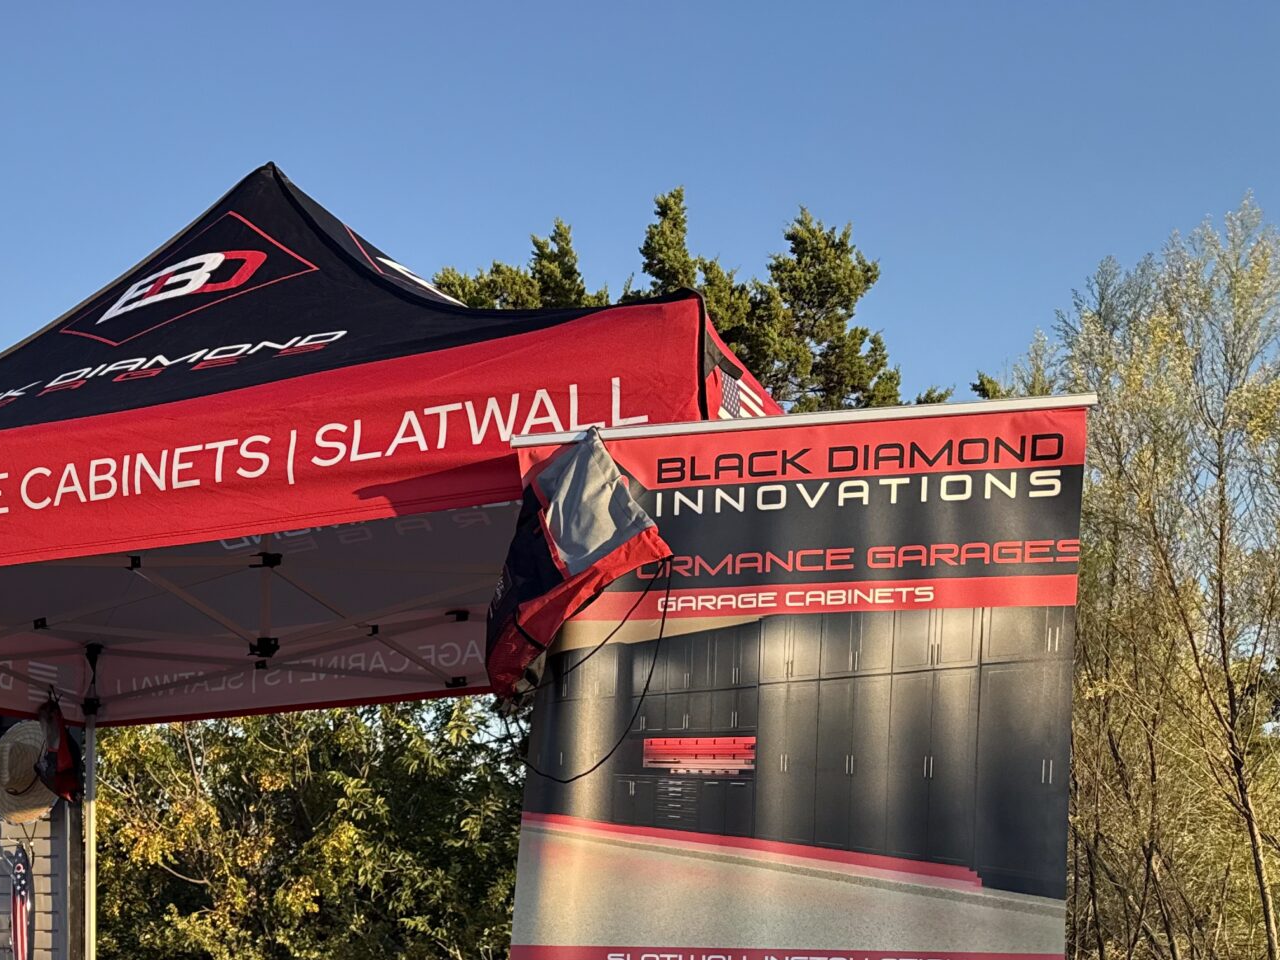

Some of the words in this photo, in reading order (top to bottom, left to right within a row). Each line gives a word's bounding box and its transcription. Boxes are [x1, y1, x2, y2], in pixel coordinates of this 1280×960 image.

[45, 330, 347, 388] DIAMOND
[22, 433, 271, 510] CABINETS
[311, 376, 649, 466] SLATWALL
[656, 447, 812, 485] BLACK
[828, 431, 1064, 474] DIAMOND
[655, 469, 1063, 518] INNOVATIONS
[866, 538, 1080, 571] GARAGES
[657, 591, 777, 613] GARAGE
[785, 586, 935, 608] CABINETS
